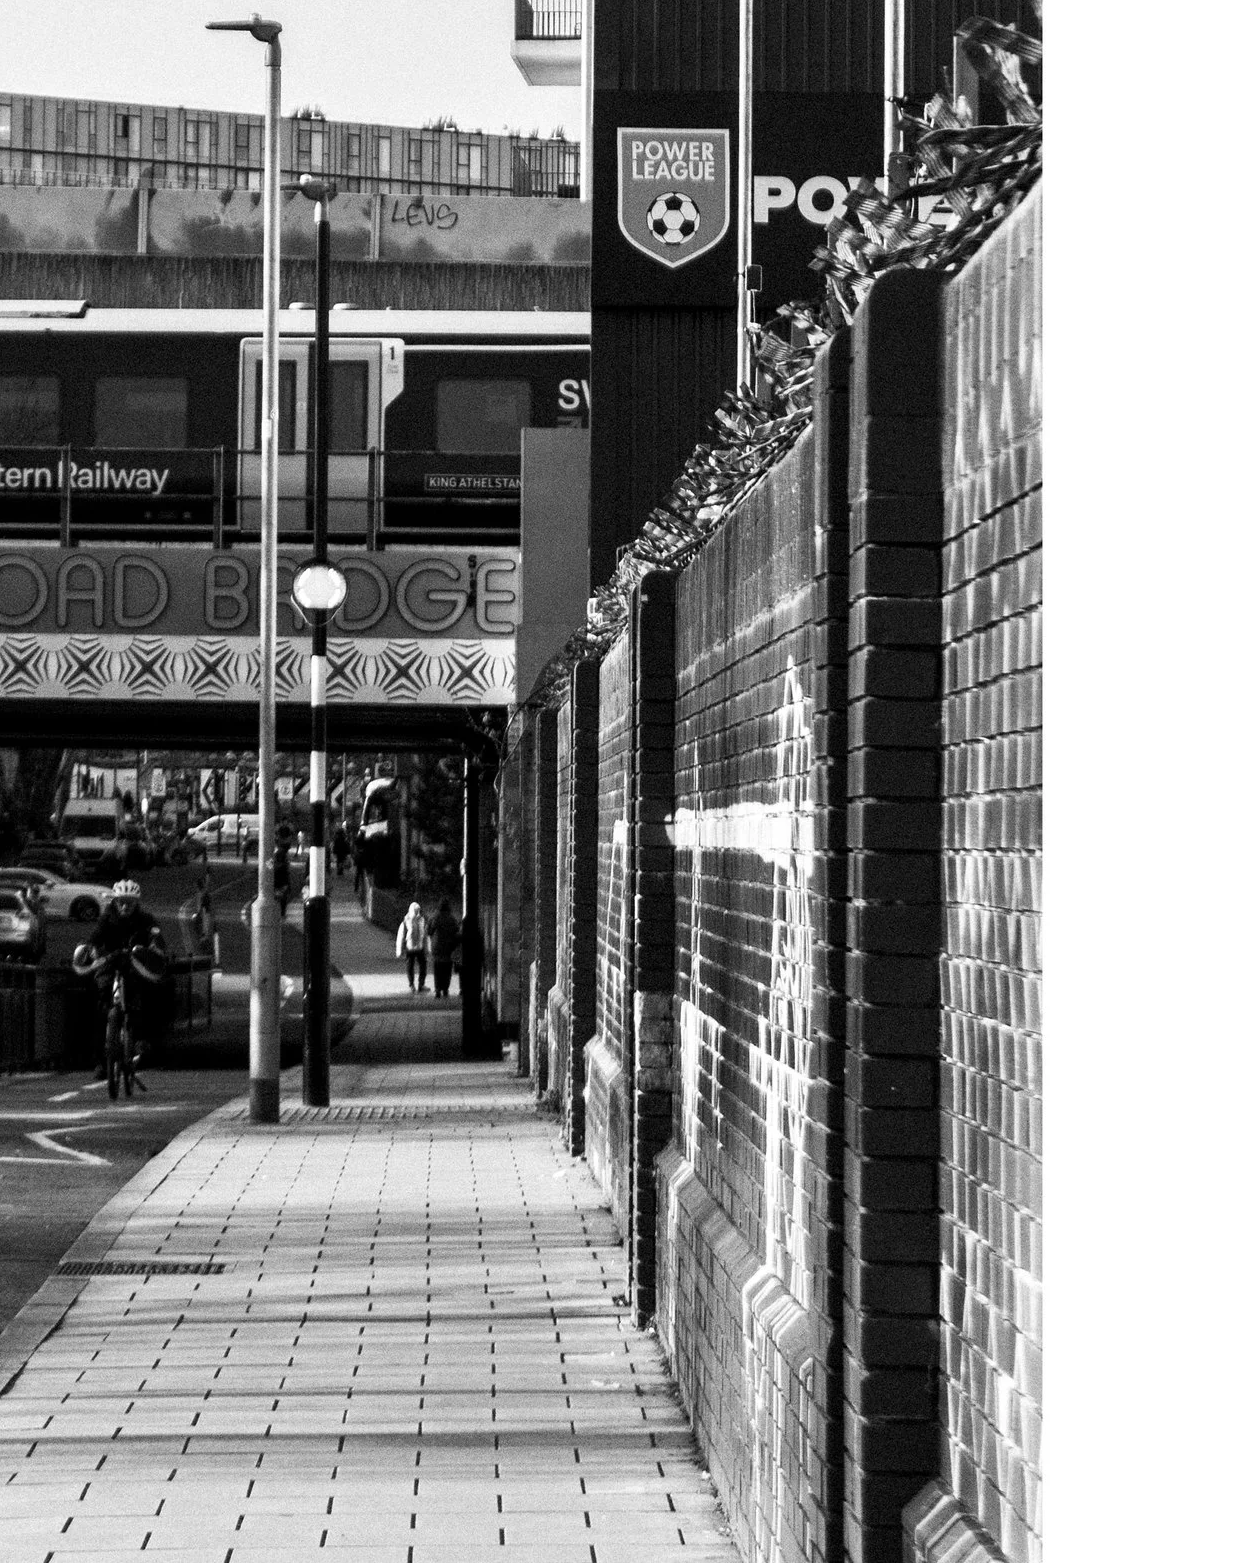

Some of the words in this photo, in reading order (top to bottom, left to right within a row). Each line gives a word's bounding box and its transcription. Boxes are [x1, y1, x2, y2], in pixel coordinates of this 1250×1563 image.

[631, 140, 715, 162] POWER
[631, 160, 715, 181] LEAGUE
[389, 345, 396, 360] 1
[557, 378, 591, 410] S
[57, 460, 170, 496] Railway
[429, 477, 457, 488] KING
[203, 554, 517, 634] BRDGE
